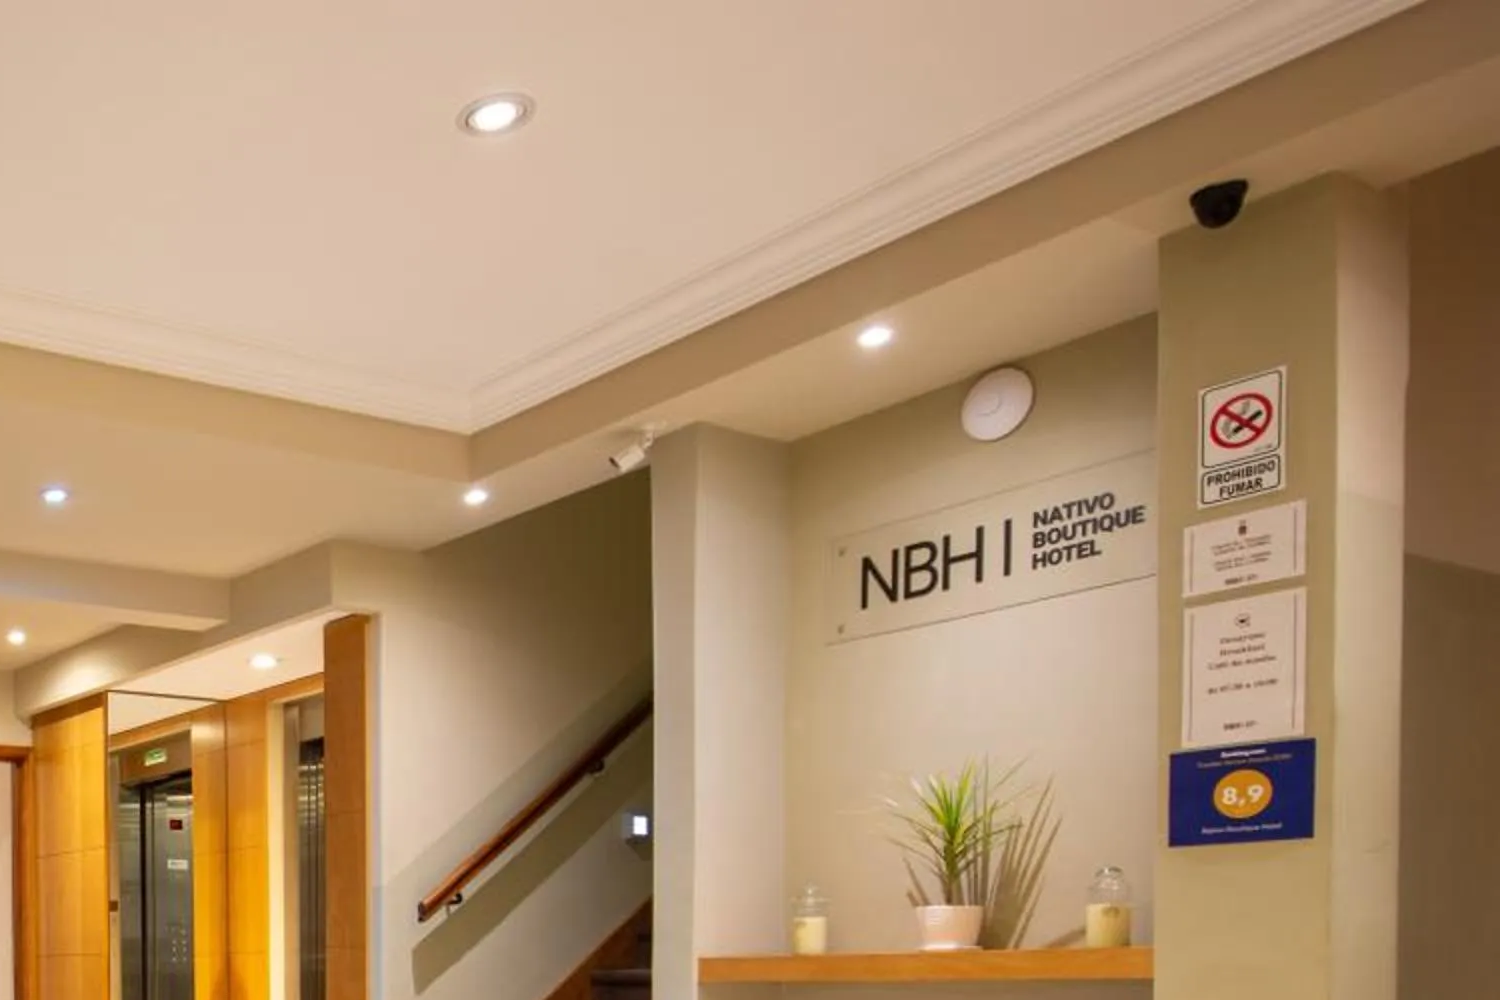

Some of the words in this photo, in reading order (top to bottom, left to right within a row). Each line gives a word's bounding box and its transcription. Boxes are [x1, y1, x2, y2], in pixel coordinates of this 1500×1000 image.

[1206, 459, 1275, 487] PROHIBIDO
[1220, 477, 1263, 498] FUMAR
[1033, 492, 1115, 528] NATIVO
[1032, 505, 1146, 549] BOUTIQUE
[861, 525, 985, 610] NBH
[1032, 540, 1102, 570] HOTEL
[1222, 784, 1264, 807] 8,9
